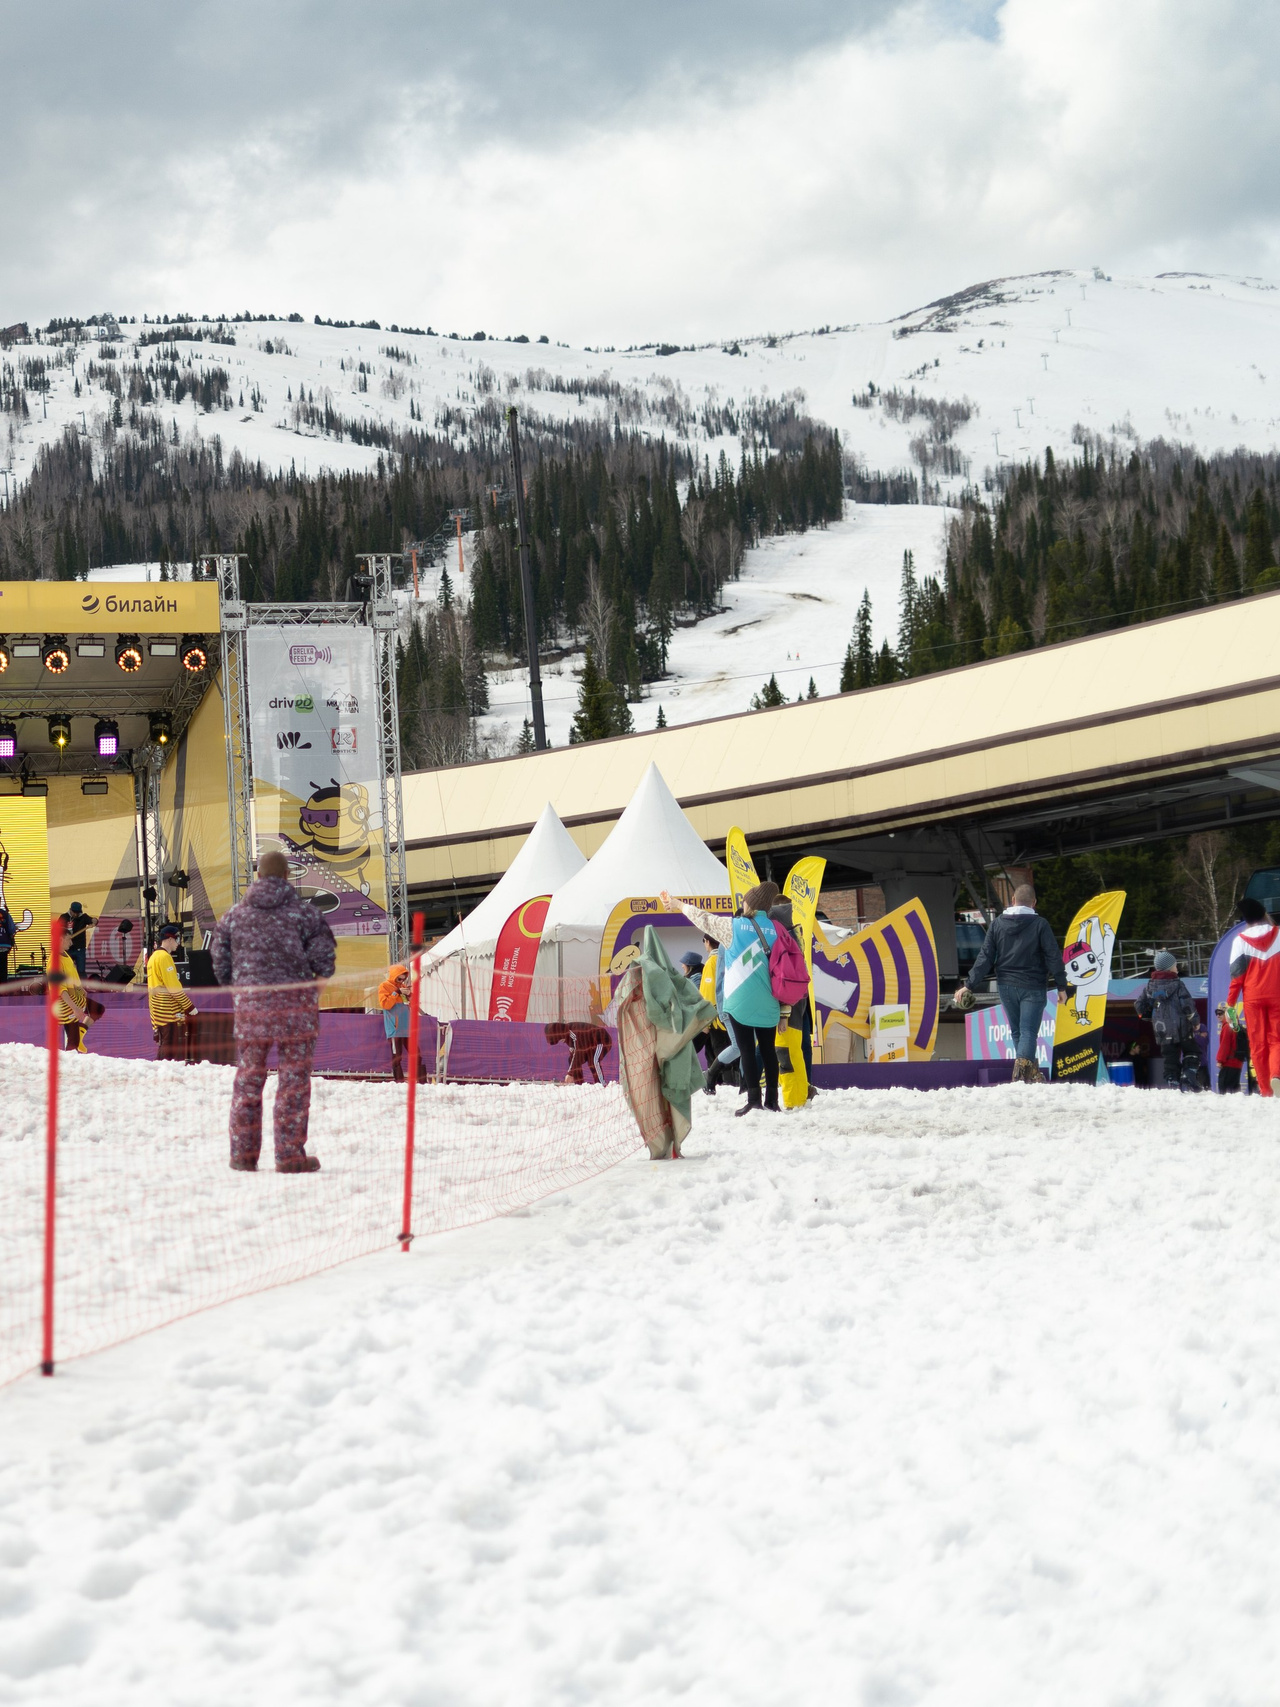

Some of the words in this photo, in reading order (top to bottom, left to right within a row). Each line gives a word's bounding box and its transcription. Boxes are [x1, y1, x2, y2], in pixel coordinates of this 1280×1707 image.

[105, 595, 177, 612] билайн
[716, 897, 733, 909] FES
[887, 1052, 896, 1060] 18
[1065, 1047, 1094, 1064] билайн
[1058, 1055, 1099, 1078] соединяет
